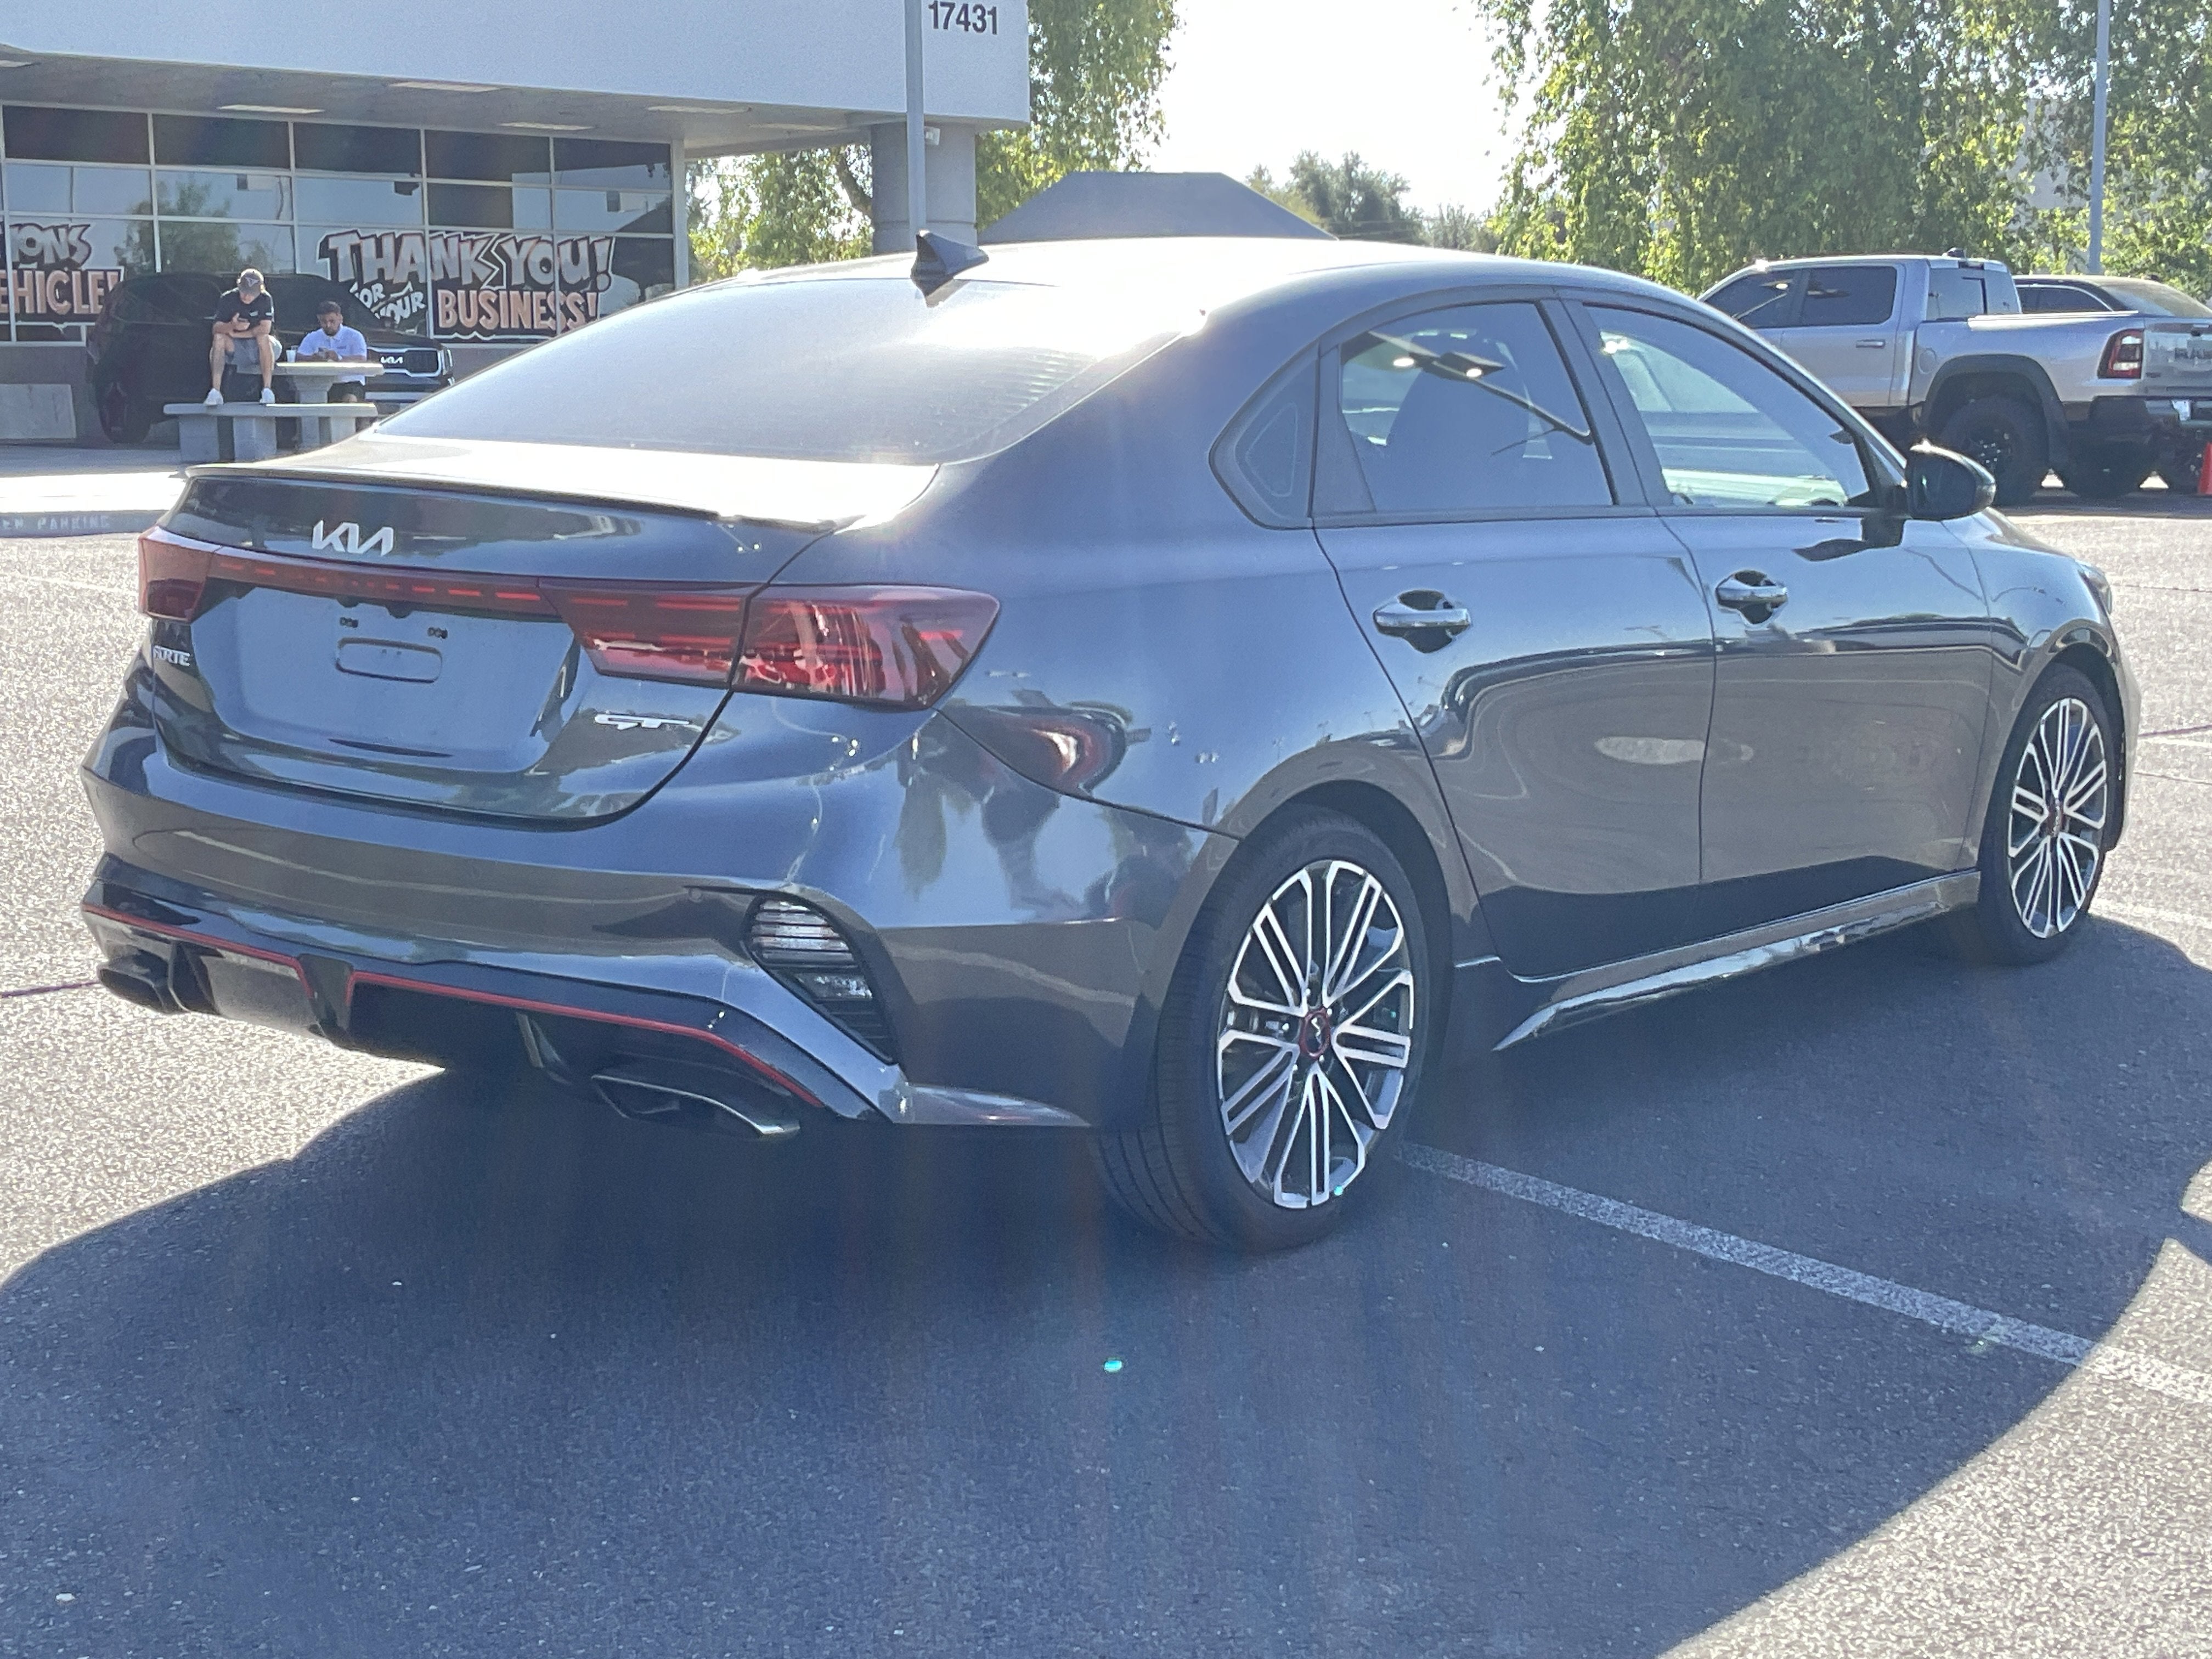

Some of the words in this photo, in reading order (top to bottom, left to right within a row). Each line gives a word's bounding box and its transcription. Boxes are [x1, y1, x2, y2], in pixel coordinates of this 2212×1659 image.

[928, 2, 997, 35] 17431
[0, 224, 91, 264] IONS
[329, 232, 492, 285] THANK
[500, 238, 610, 291] YOU!
[437, 289, 597, 330] BUSINESS!
[312, 520, 394, 556] KIA
